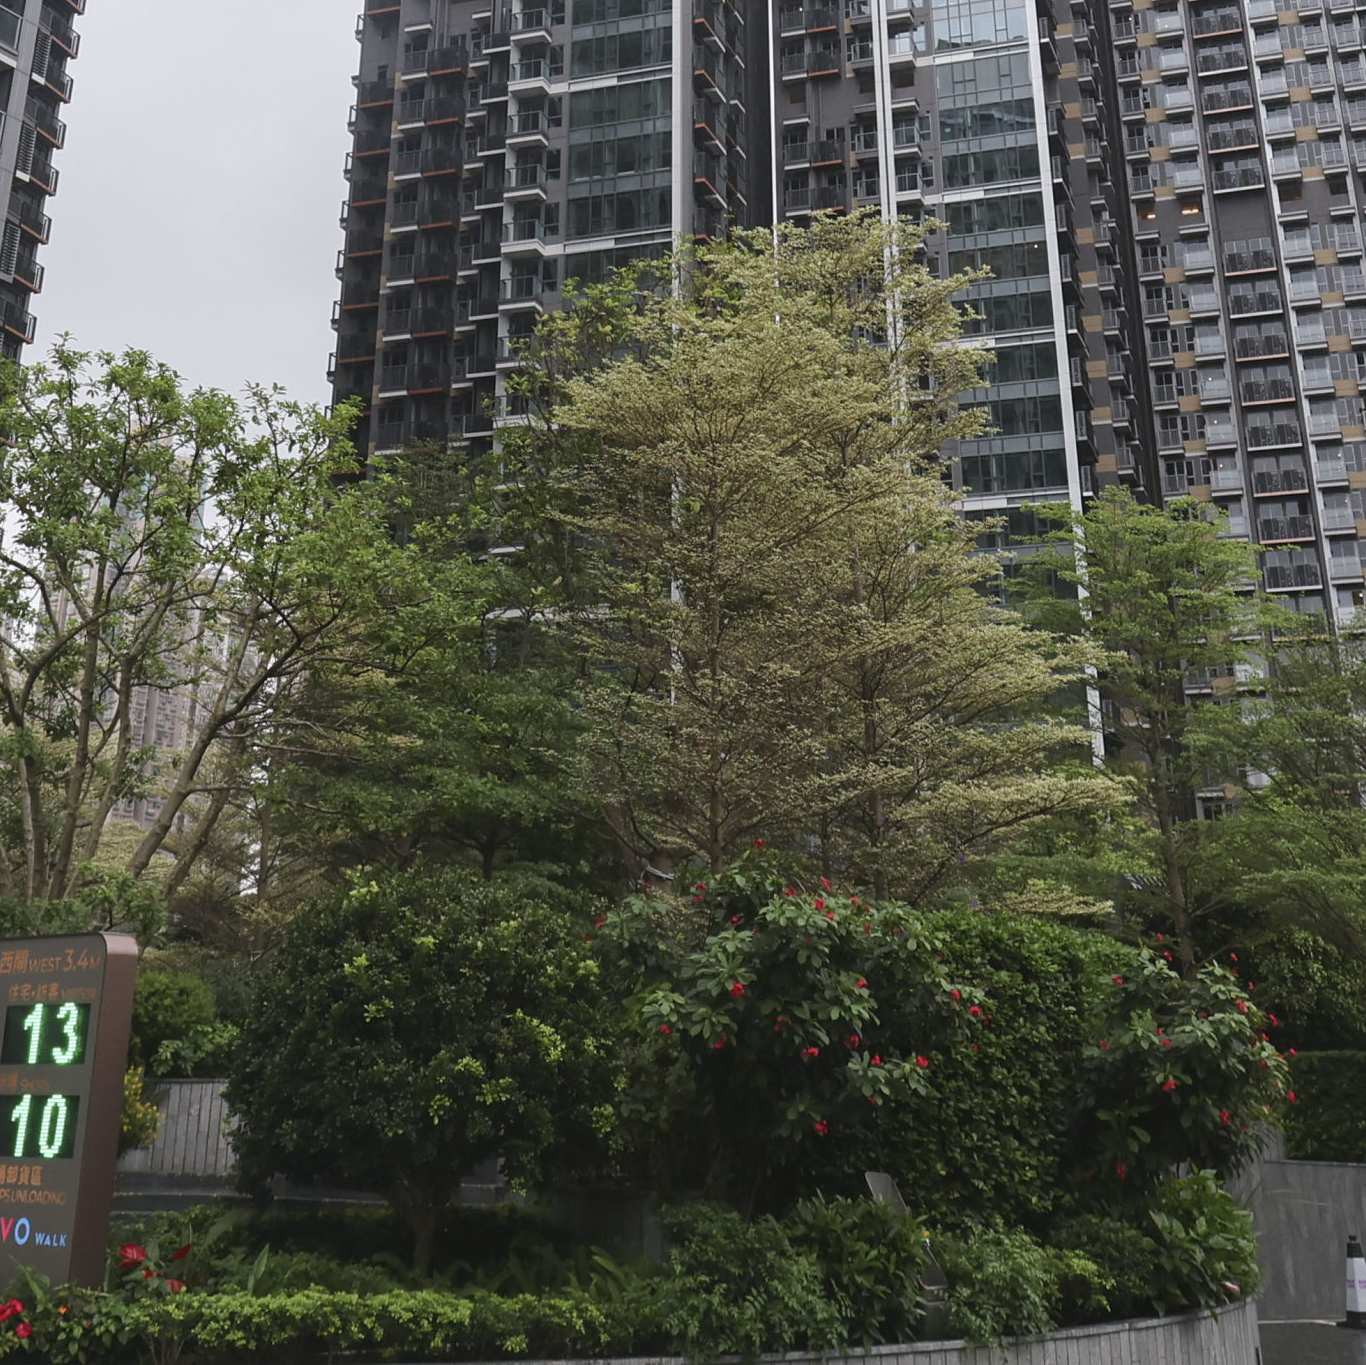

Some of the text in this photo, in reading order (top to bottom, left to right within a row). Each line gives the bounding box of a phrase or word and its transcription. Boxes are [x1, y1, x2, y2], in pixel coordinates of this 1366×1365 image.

[29, 957, 62, 972] WEST
[23, 1002, 79, 1065] 13
[10, 1093, 67, 1158] 10
[35, 1231, 67, 1247] WALK
